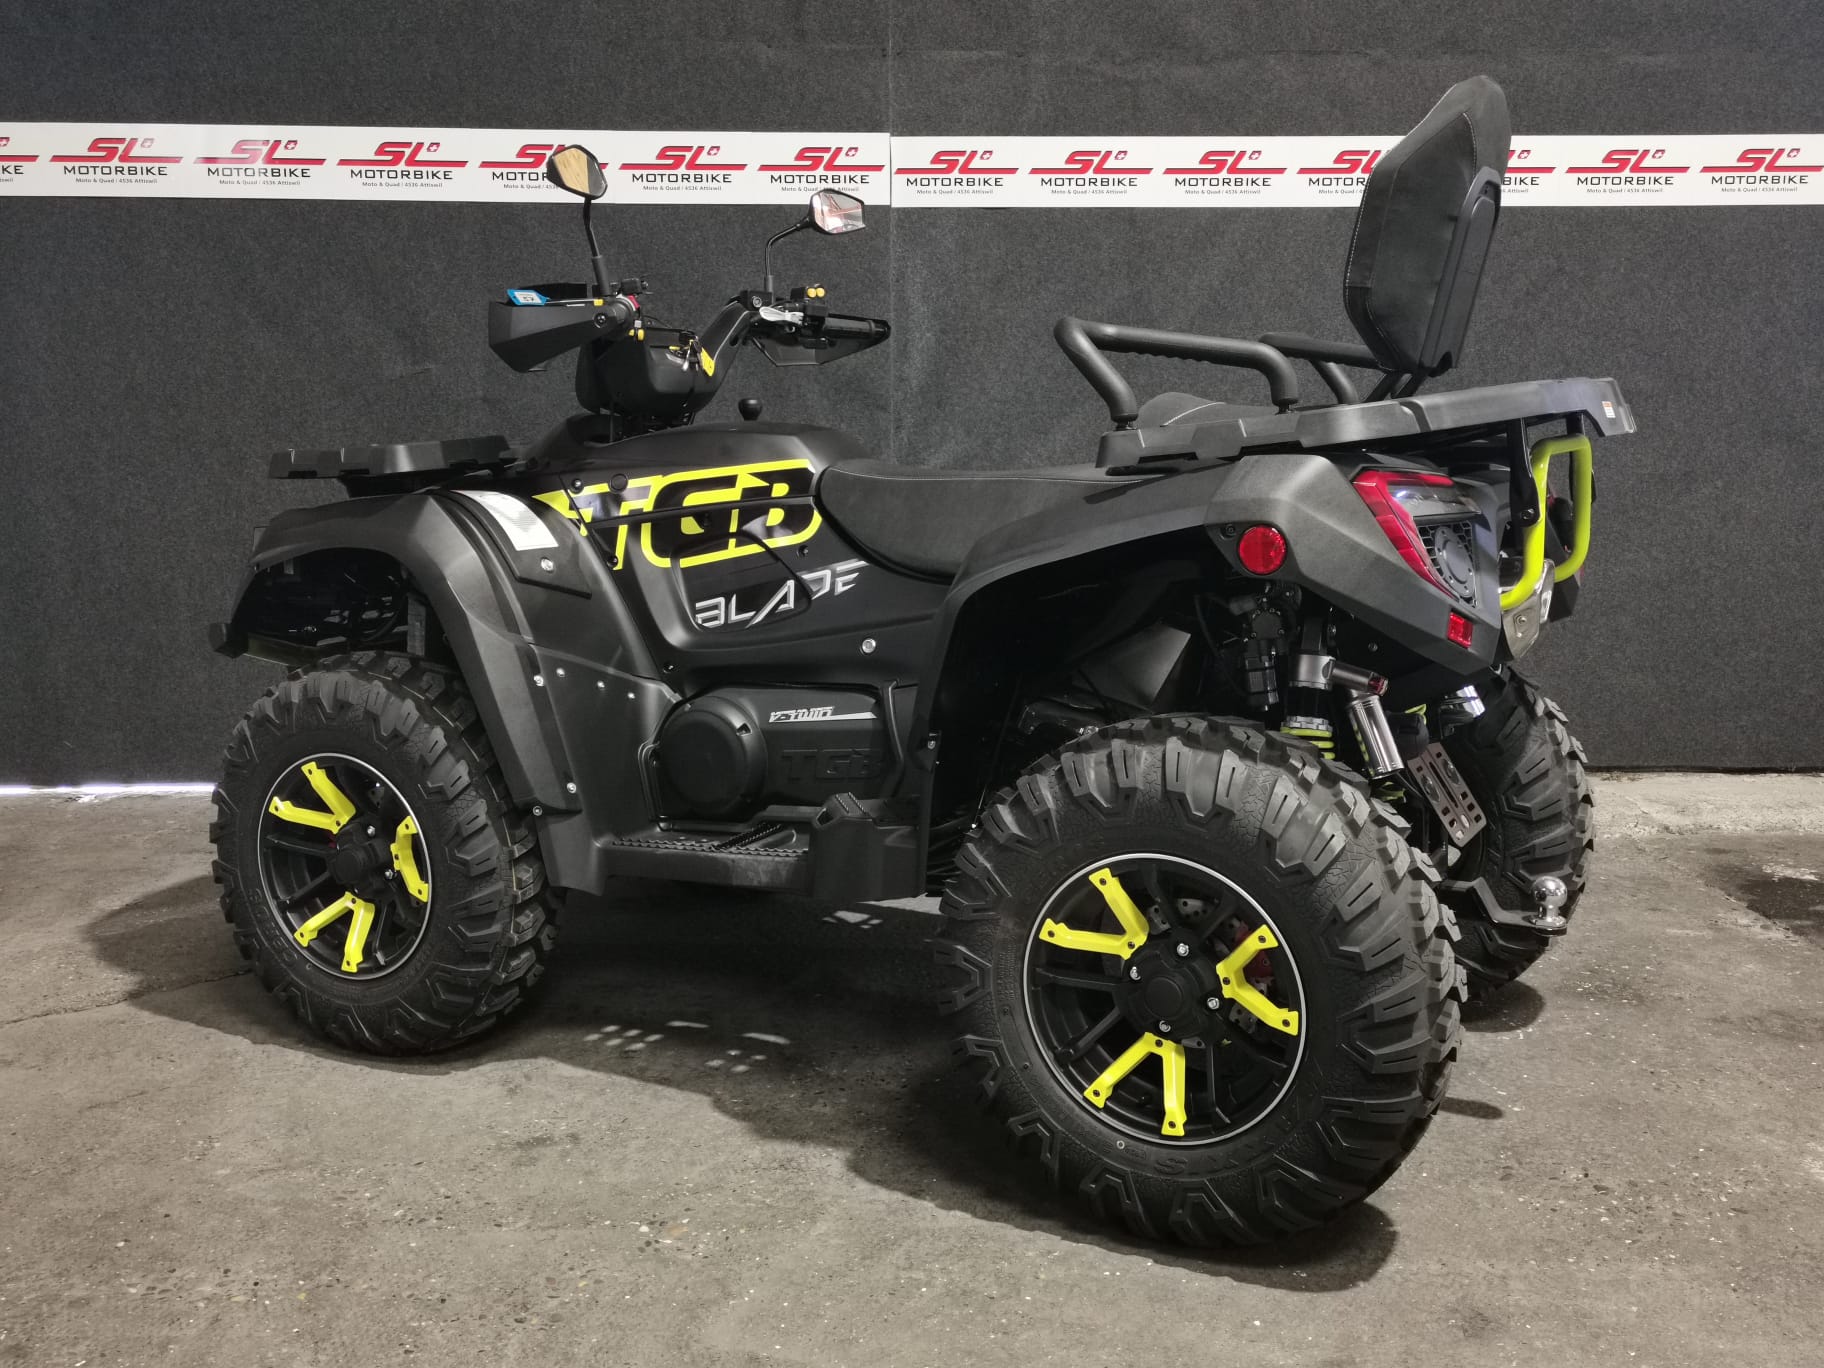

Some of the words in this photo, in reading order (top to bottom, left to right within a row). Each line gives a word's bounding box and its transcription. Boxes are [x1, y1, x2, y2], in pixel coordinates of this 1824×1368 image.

[64, 166, 168, 175] MOTORBIKE
[208, 168, 310, 177] MOTORBIKE
[351, 169, 453, 179] MOTORBIKE
[632, 174, 732, 183] MOTORBIKE
[771, 175, 870, 183] MOTORBIKE
[907, 178, 1003, 186] MOTORBIKE
[1041, 178, 1138, 186] MOTORBIKE
[1175, 178, 1271, 186] MOTORBIKE
[1577, 177, 1674, 185] MOTORBIKE
[1712, 175, 1808, 184] MOTORBIKE
[695, 559, 870, 628] BLADE
